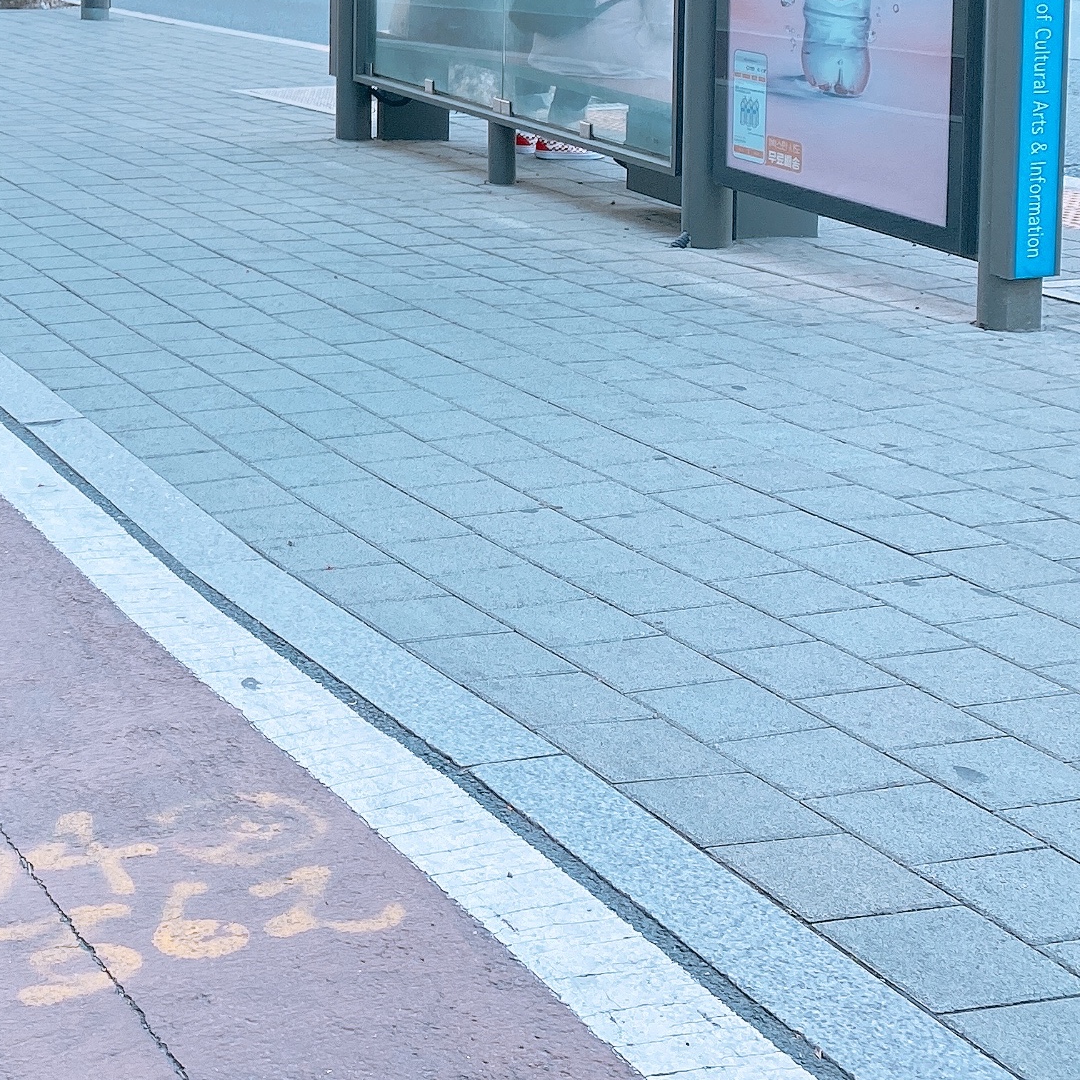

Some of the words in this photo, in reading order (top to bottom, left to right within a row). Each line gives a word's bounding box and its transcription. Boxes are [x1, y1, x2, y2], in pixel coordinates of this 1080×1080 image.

[1035, 3, 1053, 22] of
[1033, 28, 1052, 94] Cultural
[1032, 101, 1050, 135] Arts
[768, 150, 801, 170] 무료배송
[1030, 142, 1048, 155] &
[1026, 161, 1047, 258] Information
